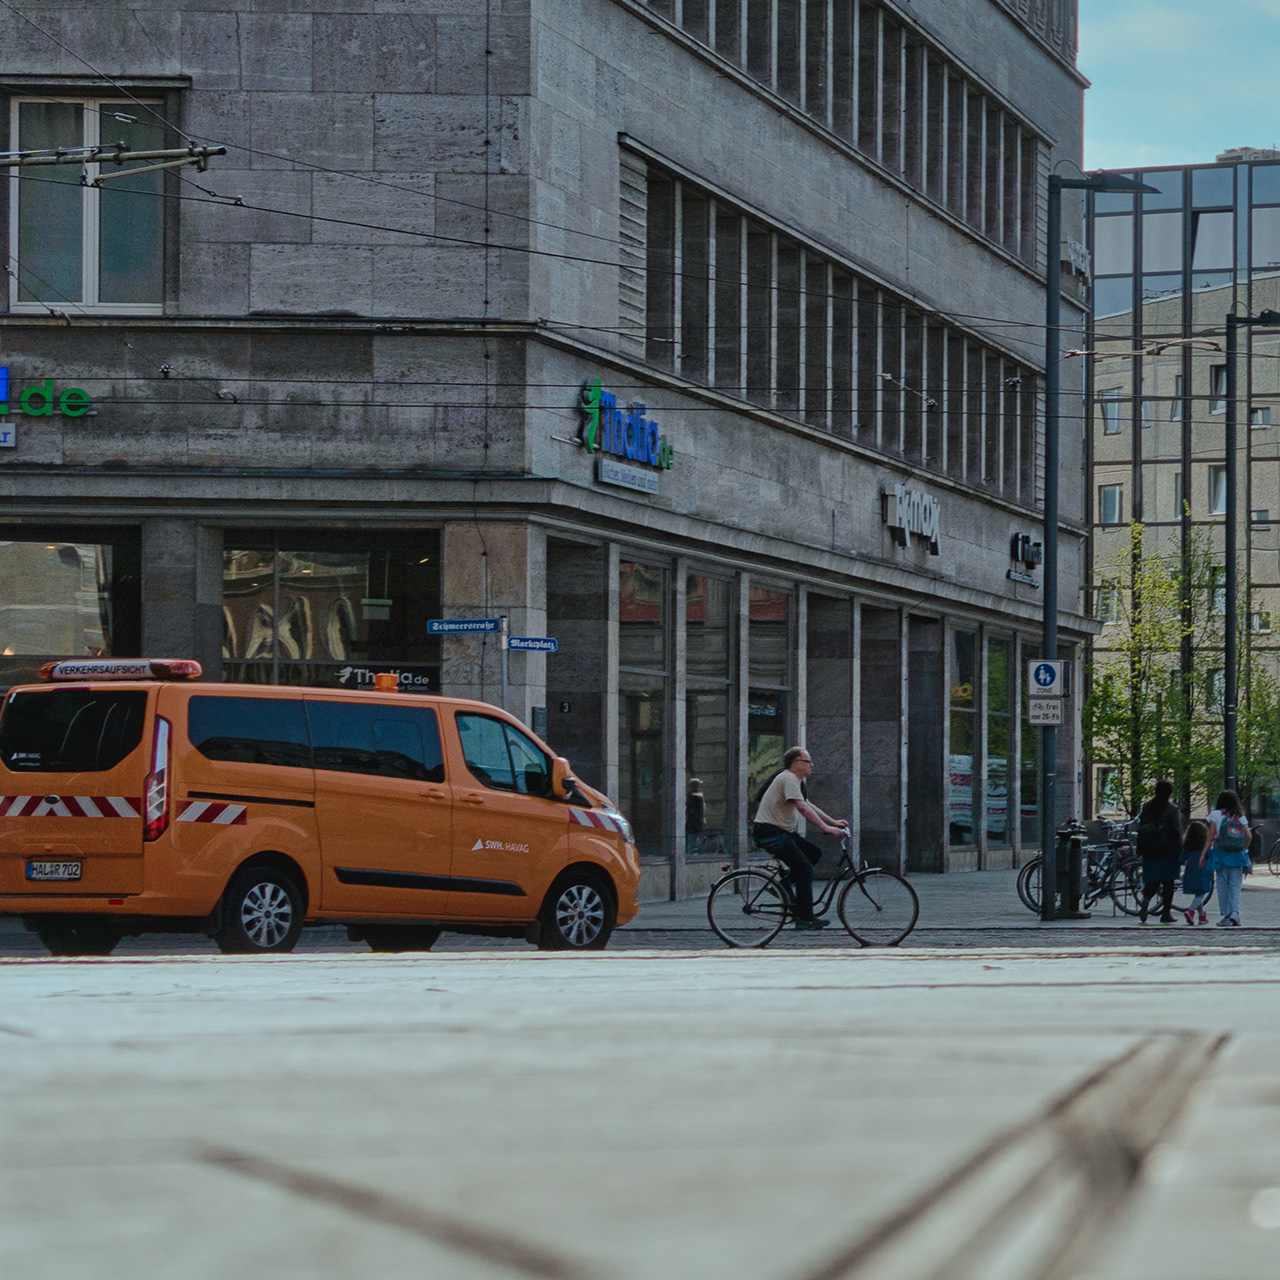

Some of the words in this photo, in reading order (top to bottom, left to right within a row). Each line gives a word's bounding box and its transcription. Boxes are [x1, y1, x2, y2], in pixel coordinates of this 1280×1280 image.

[510, 639, 555, 650] Marktplatz
[59, 665, 147, 675] VERKEHRSAUFSICHT
[563, 702, 569, 713] 3
[485, 840, 504, 850] SWH.
[505, 842, 529, 853] HAVAG
[32, 864, 49, 876] HAL
[62, 864, 79, 876] 702
